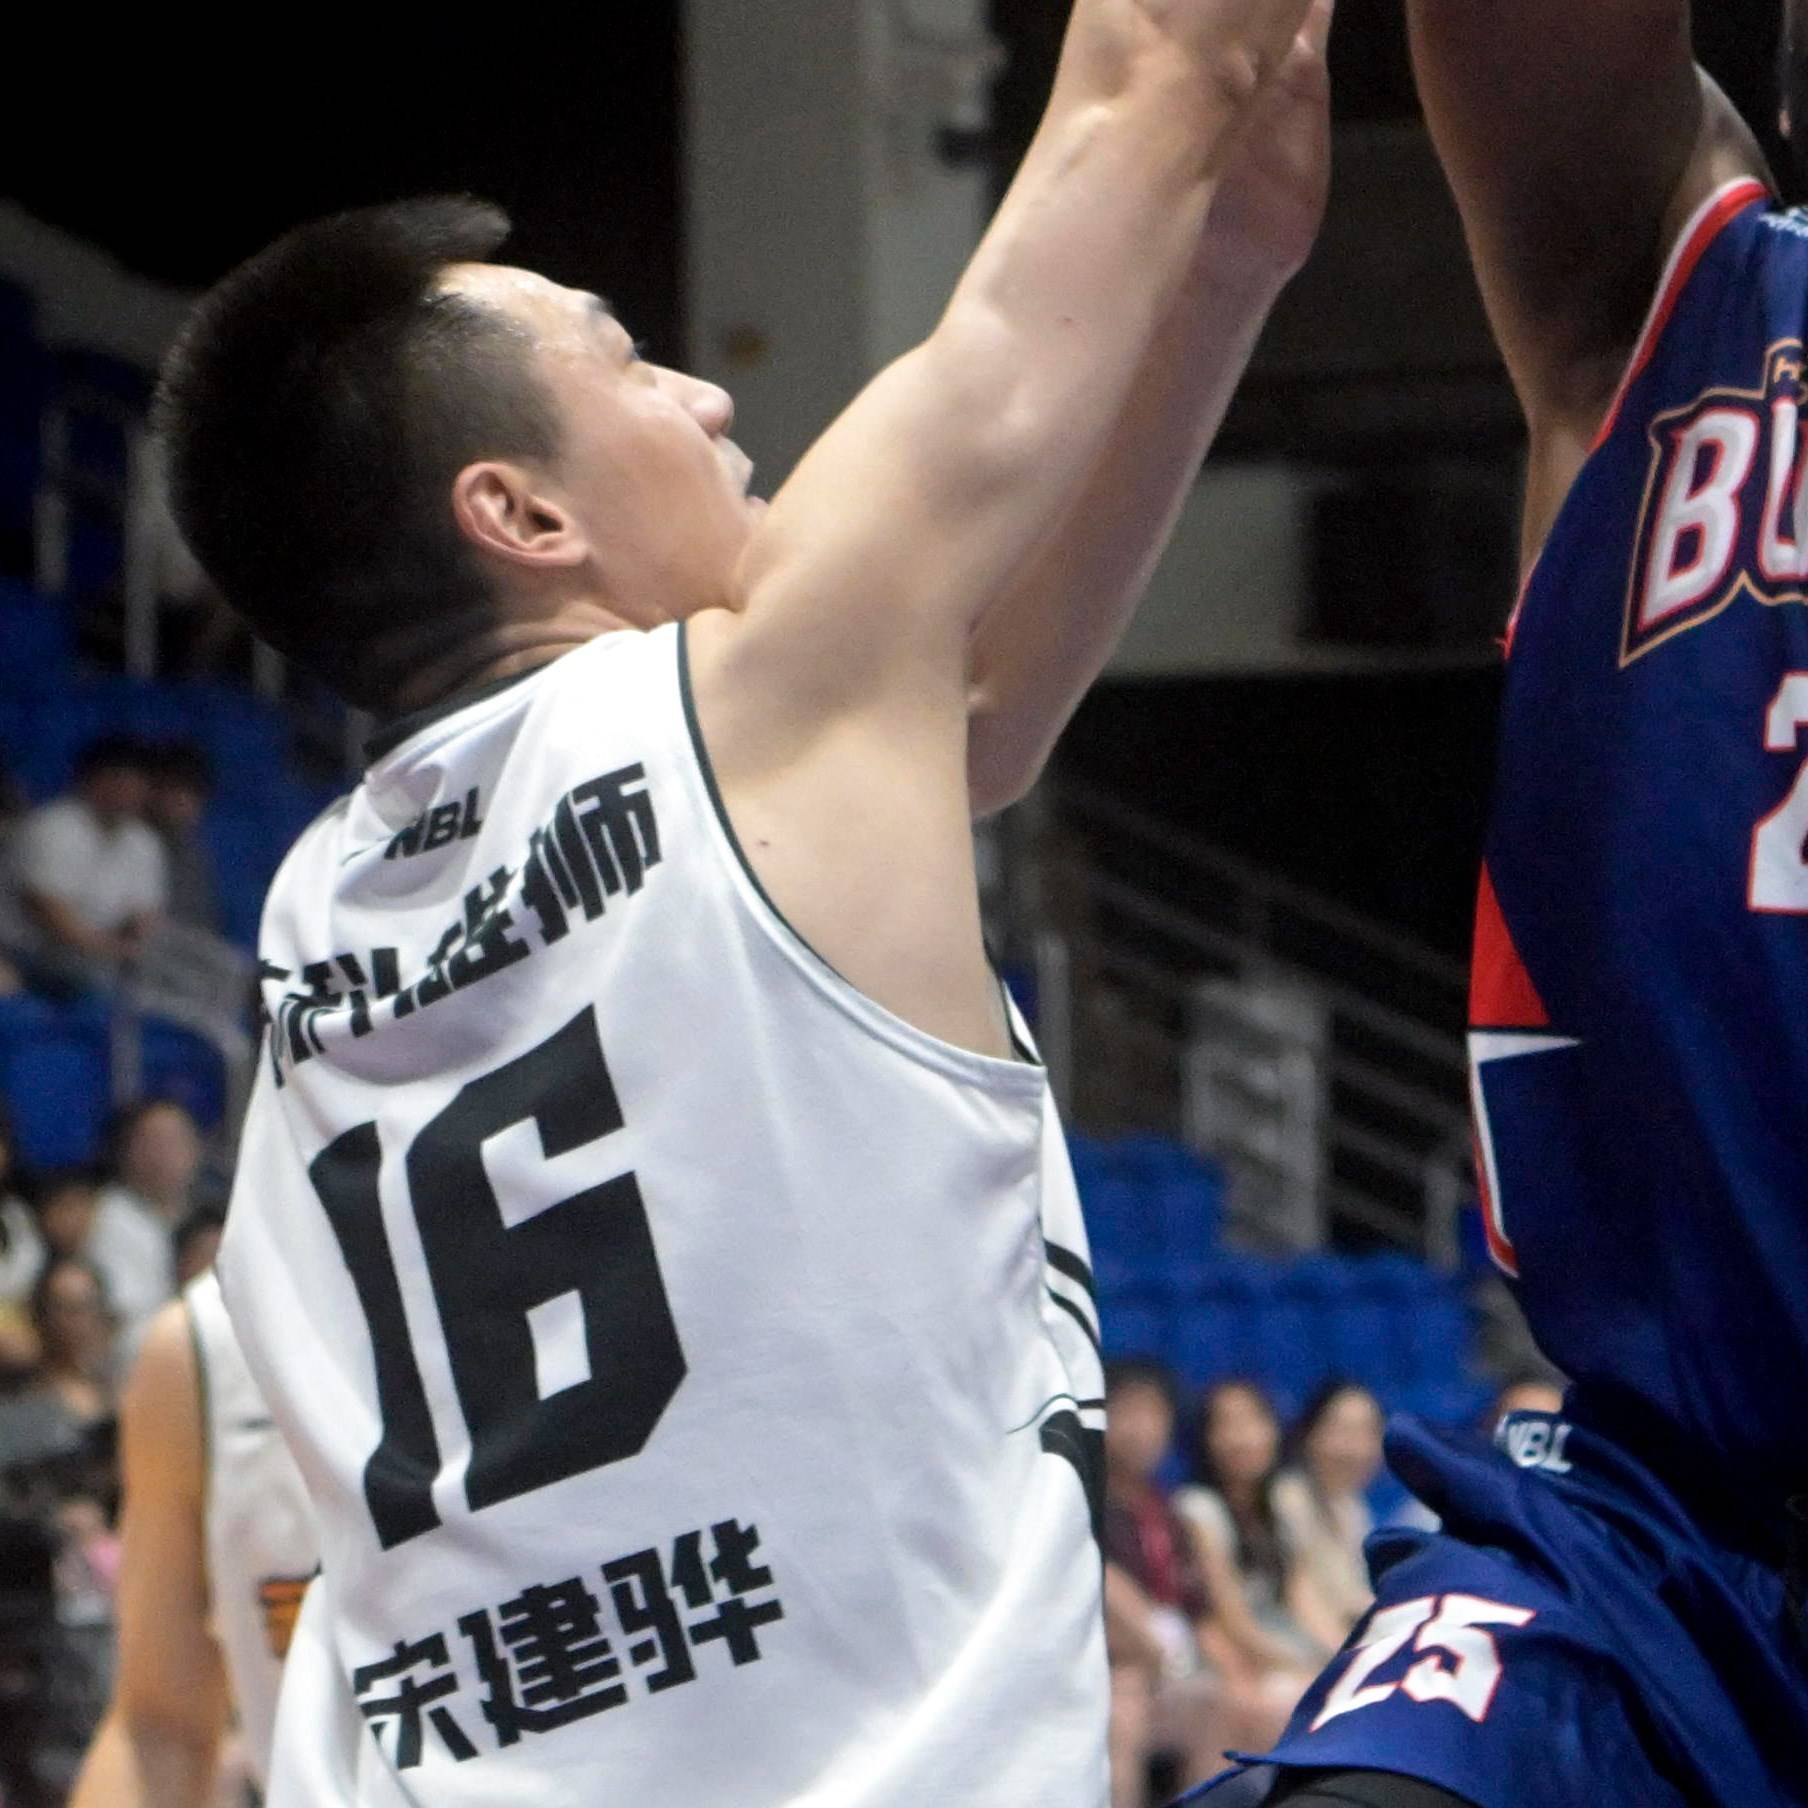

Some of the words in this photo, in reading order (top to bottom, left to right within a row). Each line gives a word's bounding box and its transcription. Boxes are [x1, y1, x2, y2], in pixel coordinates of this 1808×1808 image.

[383, 786, 483, 860] NBL
[309, 1004, 688, 1550] 16
[353, 1517, 785, 1770] 宋建骅
[1308, 1593, 1537, 1733] 25
